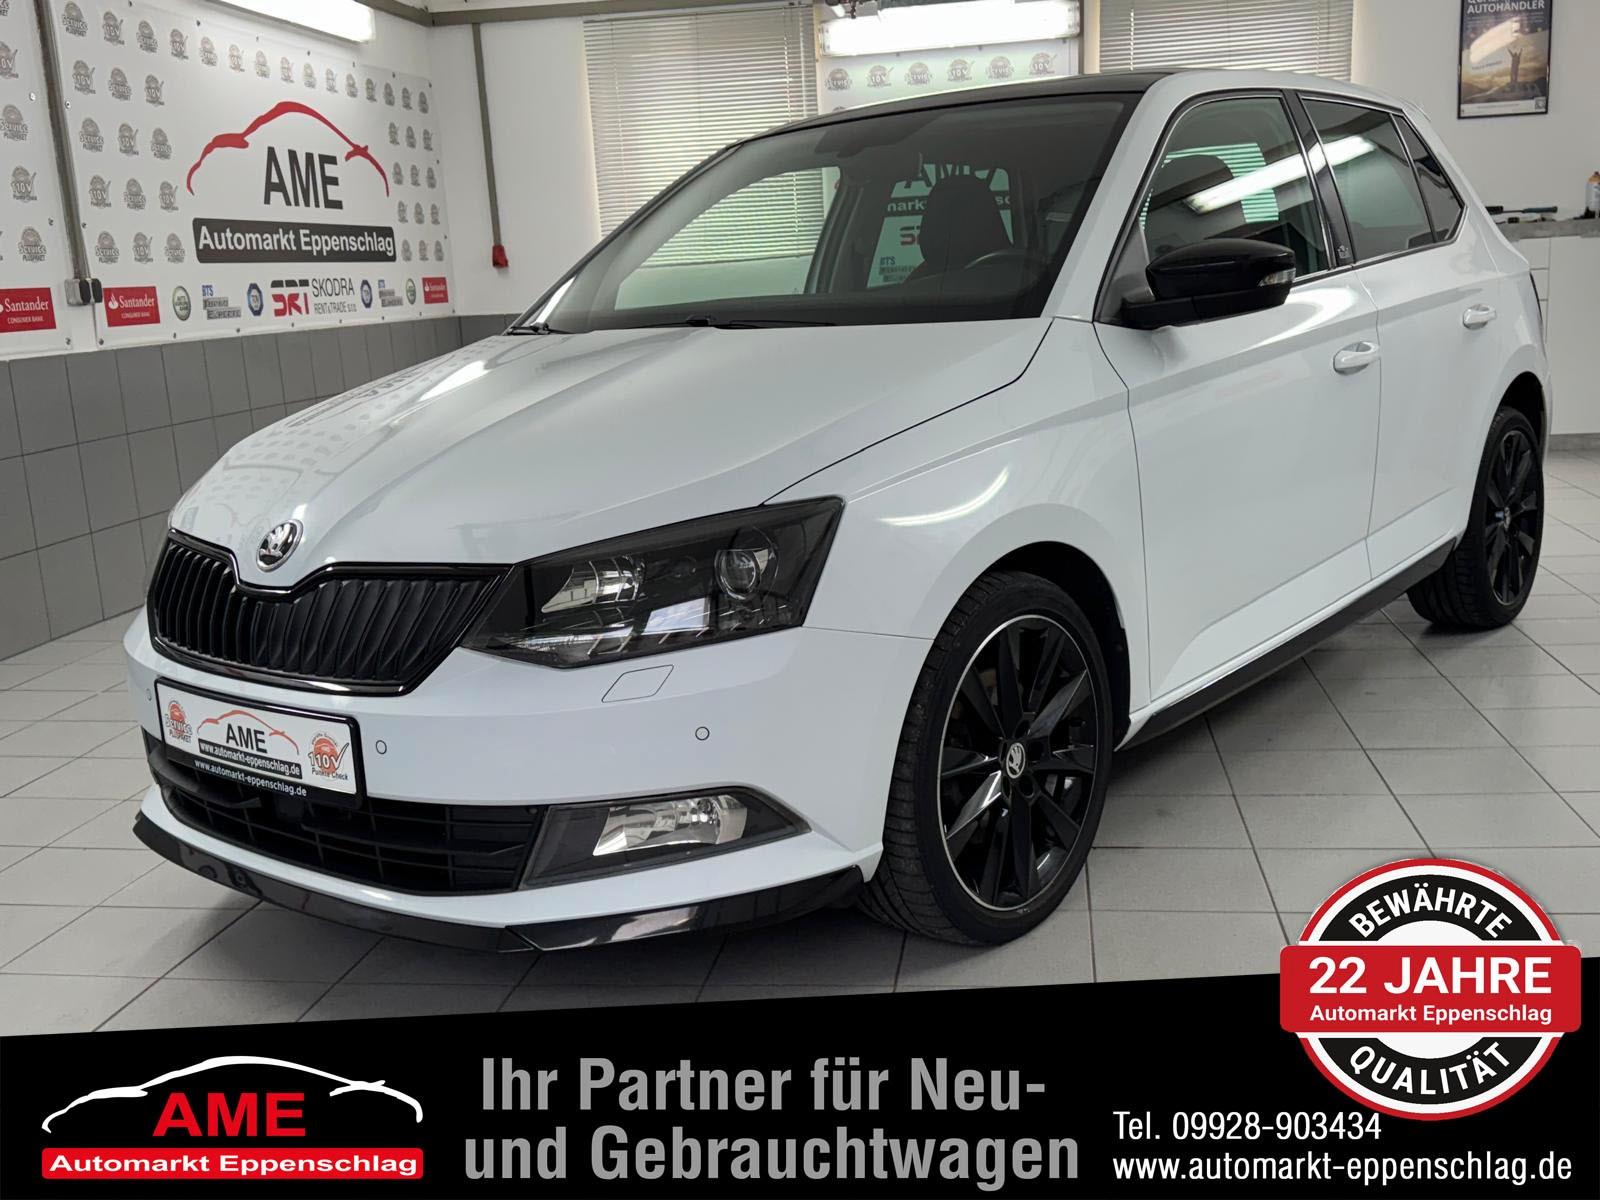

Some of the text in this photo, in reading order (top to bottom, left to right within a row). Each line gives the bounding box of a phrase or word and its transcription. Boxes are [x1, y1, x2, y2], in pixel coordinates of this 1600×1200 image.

[1467, 1, 1545, 14] AUTOHÄNDLER
[263, 146, 343, 210] AME
[198, 226, 394, 256] Automarkt Eppenschlag
[311, 278, 355, 297] SKODRA
[4, 296, 49, 313] Santander
[119, 293, 155, 308] Santander
[226, 723, 268, 754] AME
[200, 742, 300, 776] www.automarkt-eppenschlag.de
[194, 760, 307, 797] www.automarkt-eppenschlag.de
[331, 771, 348, 781] Check
